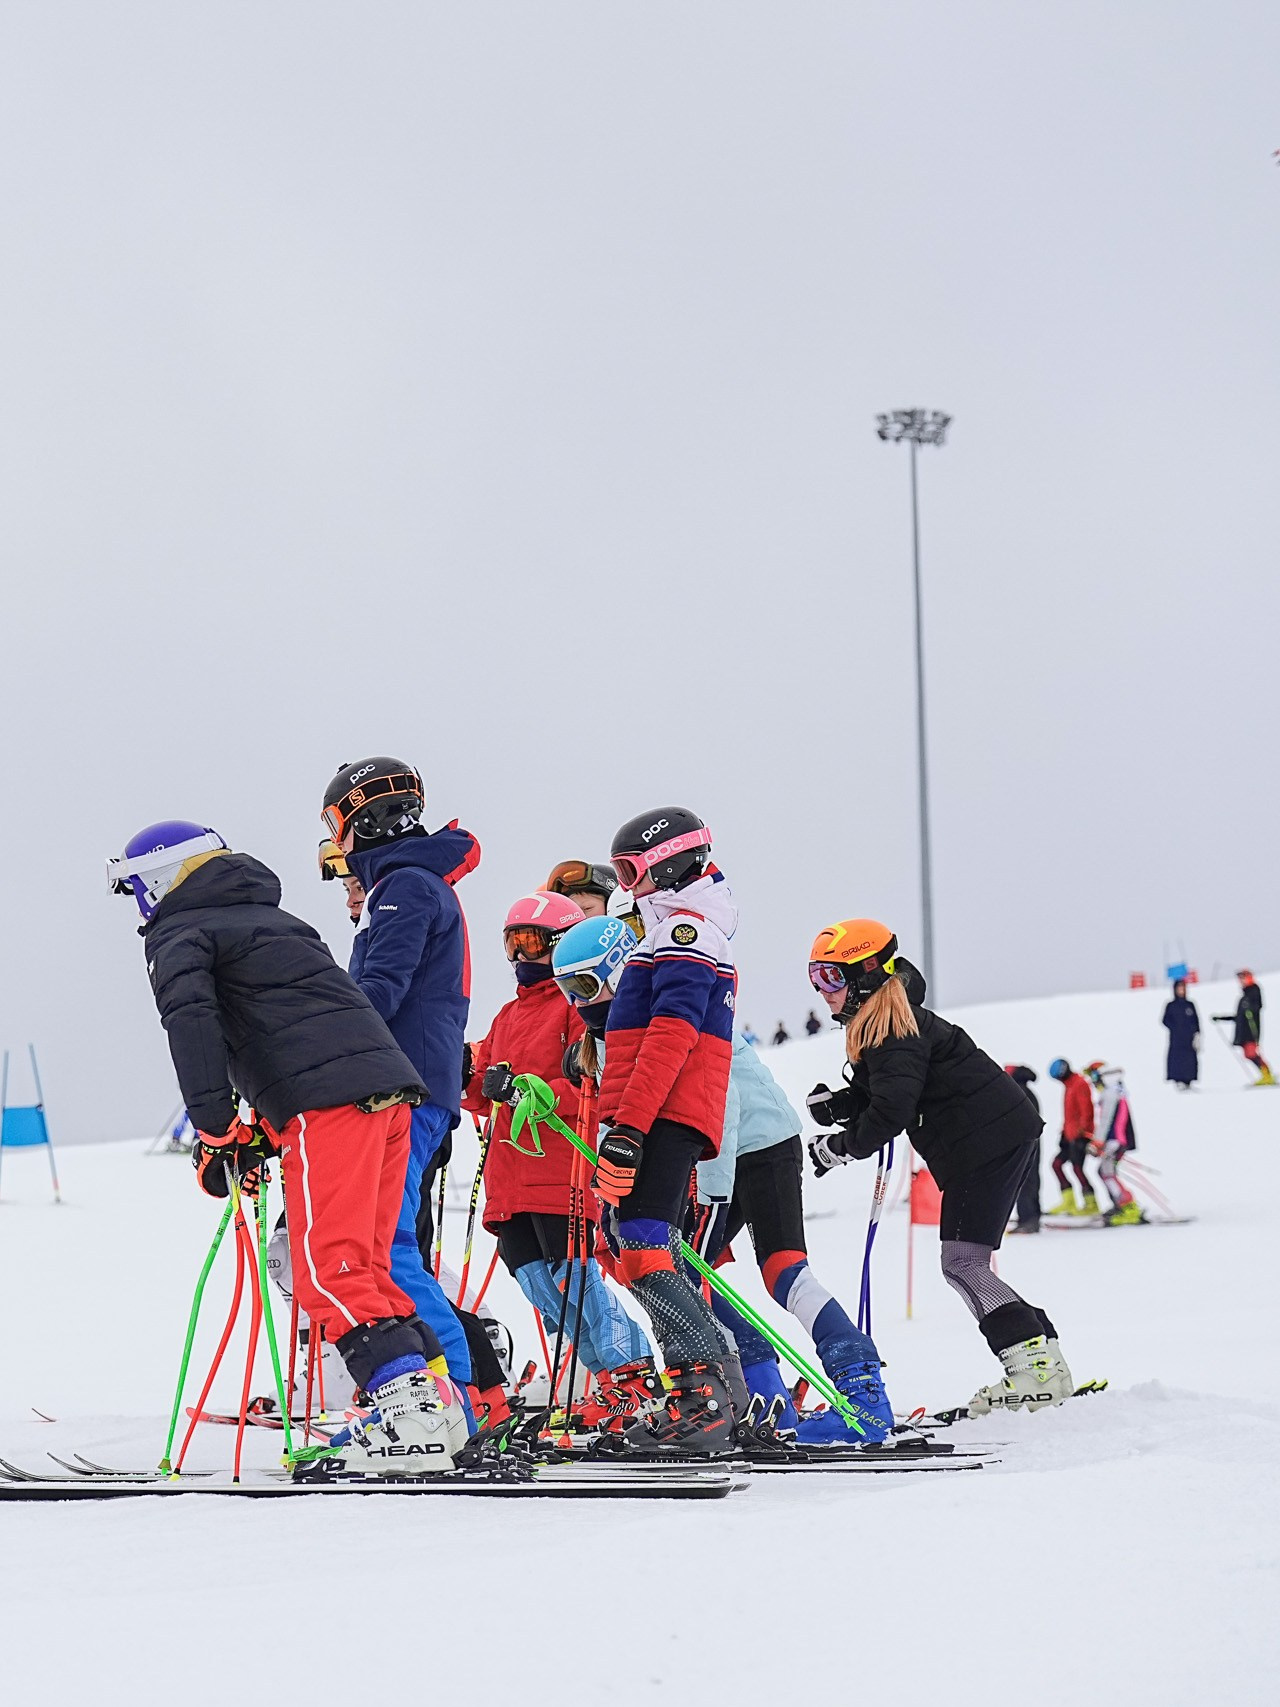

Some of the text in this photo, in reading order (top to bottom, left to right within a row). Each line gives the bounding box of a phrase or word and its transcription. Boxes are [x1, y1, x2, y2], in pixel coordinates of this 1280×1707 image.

[841, 941, 871, 958] BRIKO
[605, 1144, 634, 1157] reusch
[987, 1392, 1054, 1407] HEAD
[860, 1411, 887, 1429] RACE
[367, 1443, 446, 1458] HEAD
